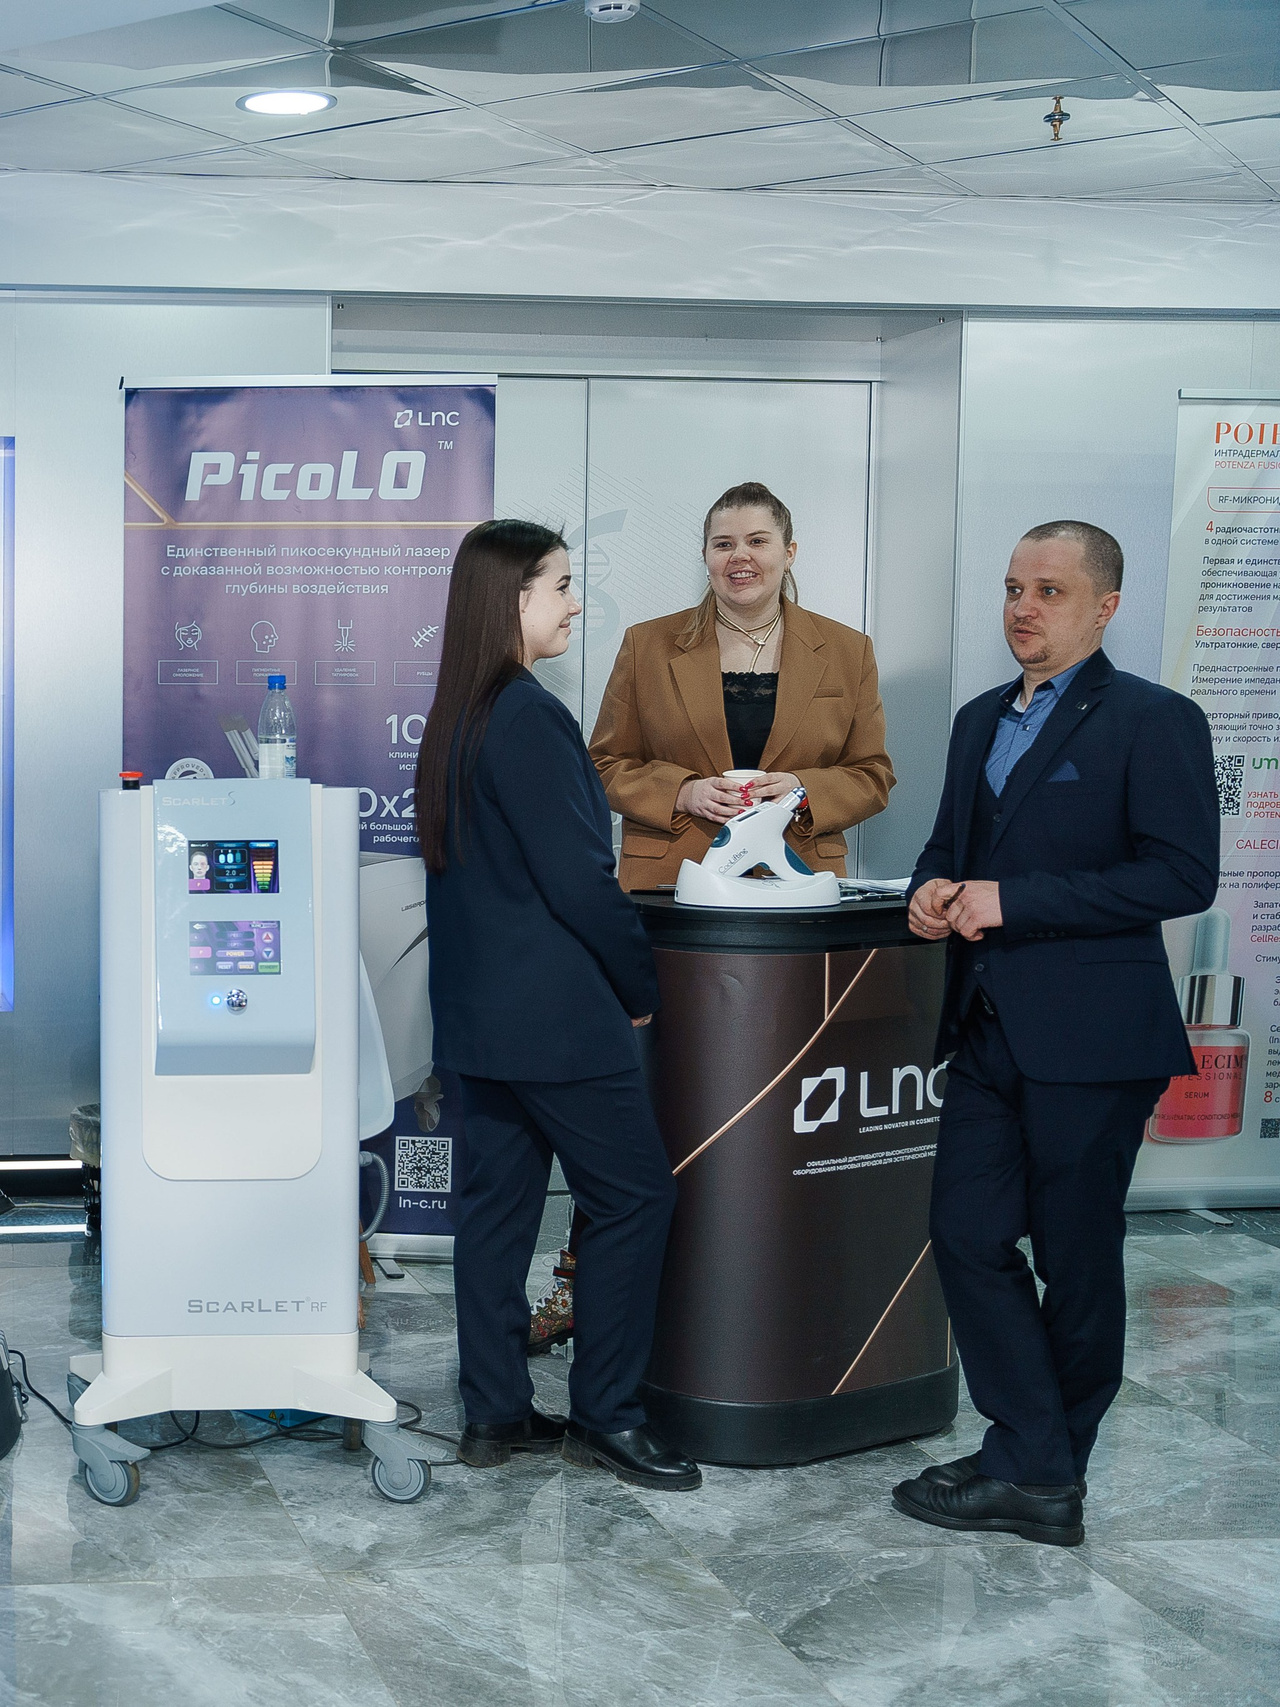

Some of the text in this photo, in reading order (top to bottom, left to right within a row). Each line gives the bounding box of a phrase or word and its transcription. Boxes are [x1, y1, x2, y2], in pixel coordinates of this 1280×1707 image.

[1214, 460, 1256, 469] POTENZA
[1218, 495, 1280, 505] RF-МИКРОНИ
[1205, 520, 1214, 533] 4
[1211, 537, 1238, 546] одной
[1239, 538, 1279, 546] системе
[166, 544, 451, 560] Единственный пикосекундный лазер
[1202, 556, 1235, 566] Первая
[160, 563, 454, 578] с доказанной возможностью контроля
[1201, 568, 1278, 578] обеспечивающая
[225, 581, 389, 596] глубины воздействия
[1200, 581, 1272, 591] проникновение
[1198, 593, 1271, 602] для достижения
[1198, 605, 1253, 614] результатов
[1196, 624, 1280, 638] Безопасность
[1194, 640, 1260, 650] Ультратонкие,
[1192, 663, 1274, 673] Преднастроенные
[1191, 675, 1243, 685] Измерение
[1190, 688, 1277, 697] реального времени
[1204, 711, 1280, 721] ерторный приво
[1232, 735, 1272, 744] скорость
[1247, 791, 1279, 799] УЗНАТЬ
[369, 822, 414, 831] большой
[373, 834, 420, 845] рабочего
[1235, 839, 1280, 850] CALECI
[1184, 1091, 1210, 1099] SERUM
[1263, 1090, 1273, 1103] 8
[858, 1124, 883, 1133] LEADING
[884, 1121, 909, 1130] NOVATOR
[398, 1196, 447, 1209] ln-c.ru
[310, 1301, 328, 1312] RF
